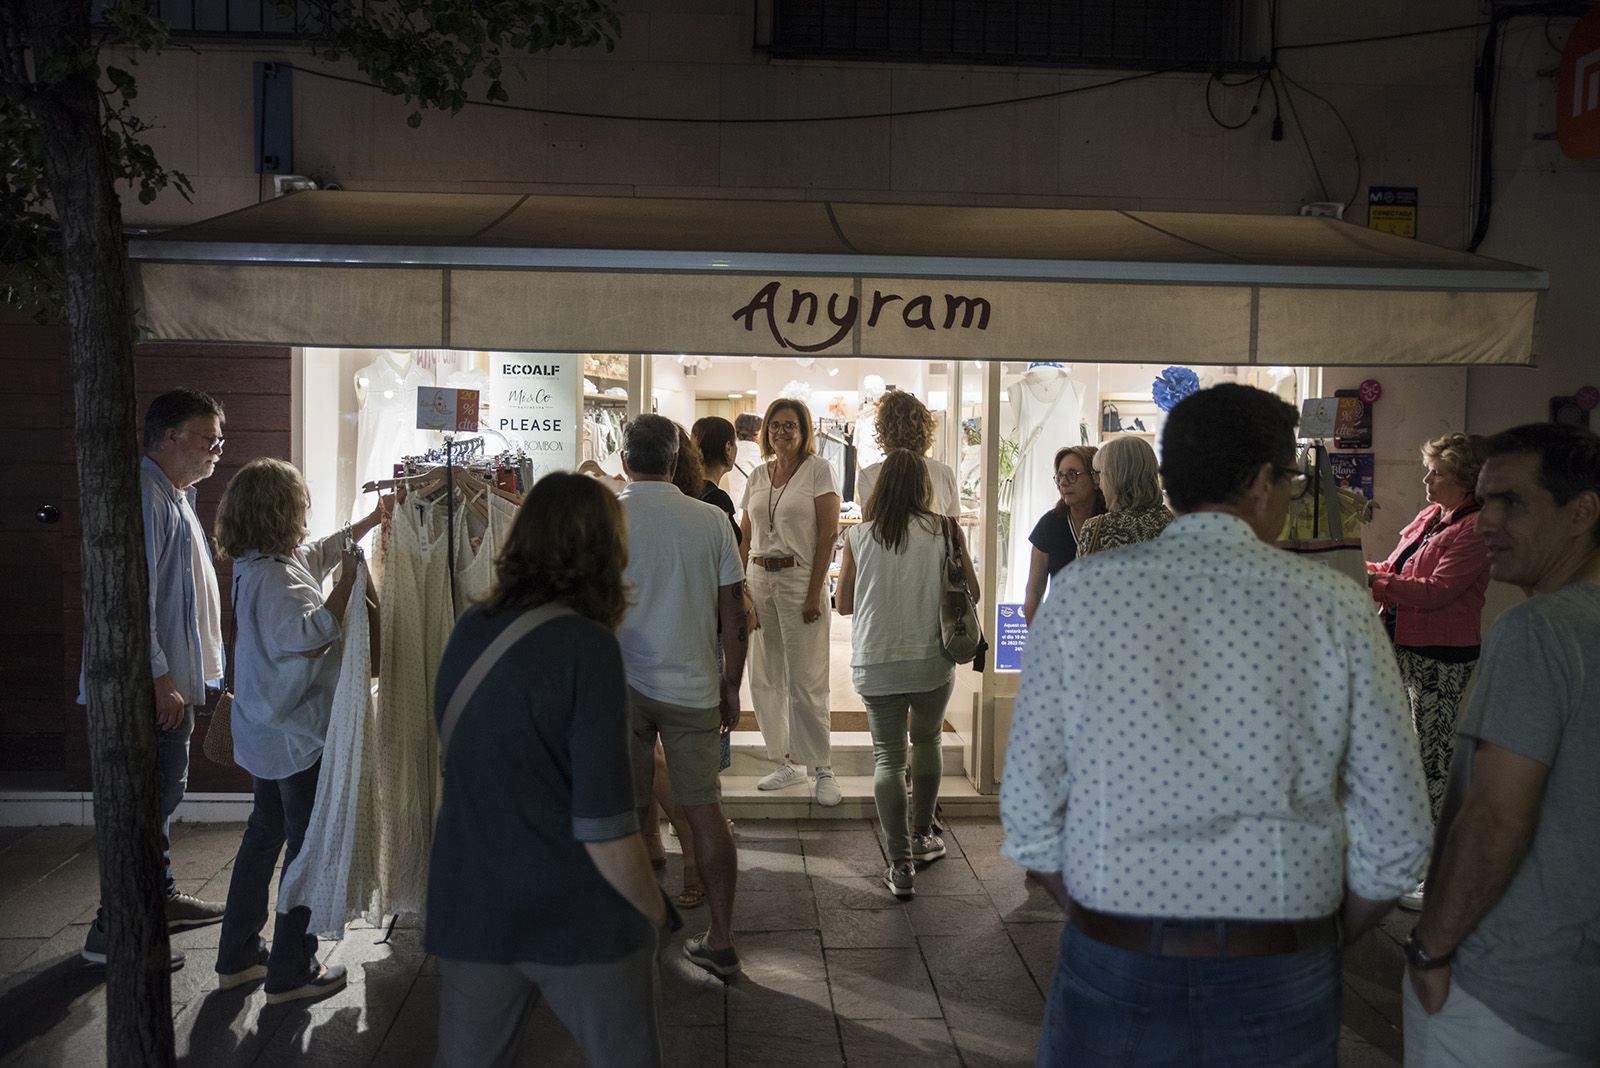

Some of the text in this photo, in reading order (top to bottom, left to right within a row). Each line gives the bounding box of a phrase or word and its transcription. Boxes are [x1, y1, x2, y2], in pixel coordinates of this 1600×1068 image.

[732, 281, 991, 352] Anyram
[502, 364, 560, 376] ECOALF
[500, 418, 562, 431] PLEASE
